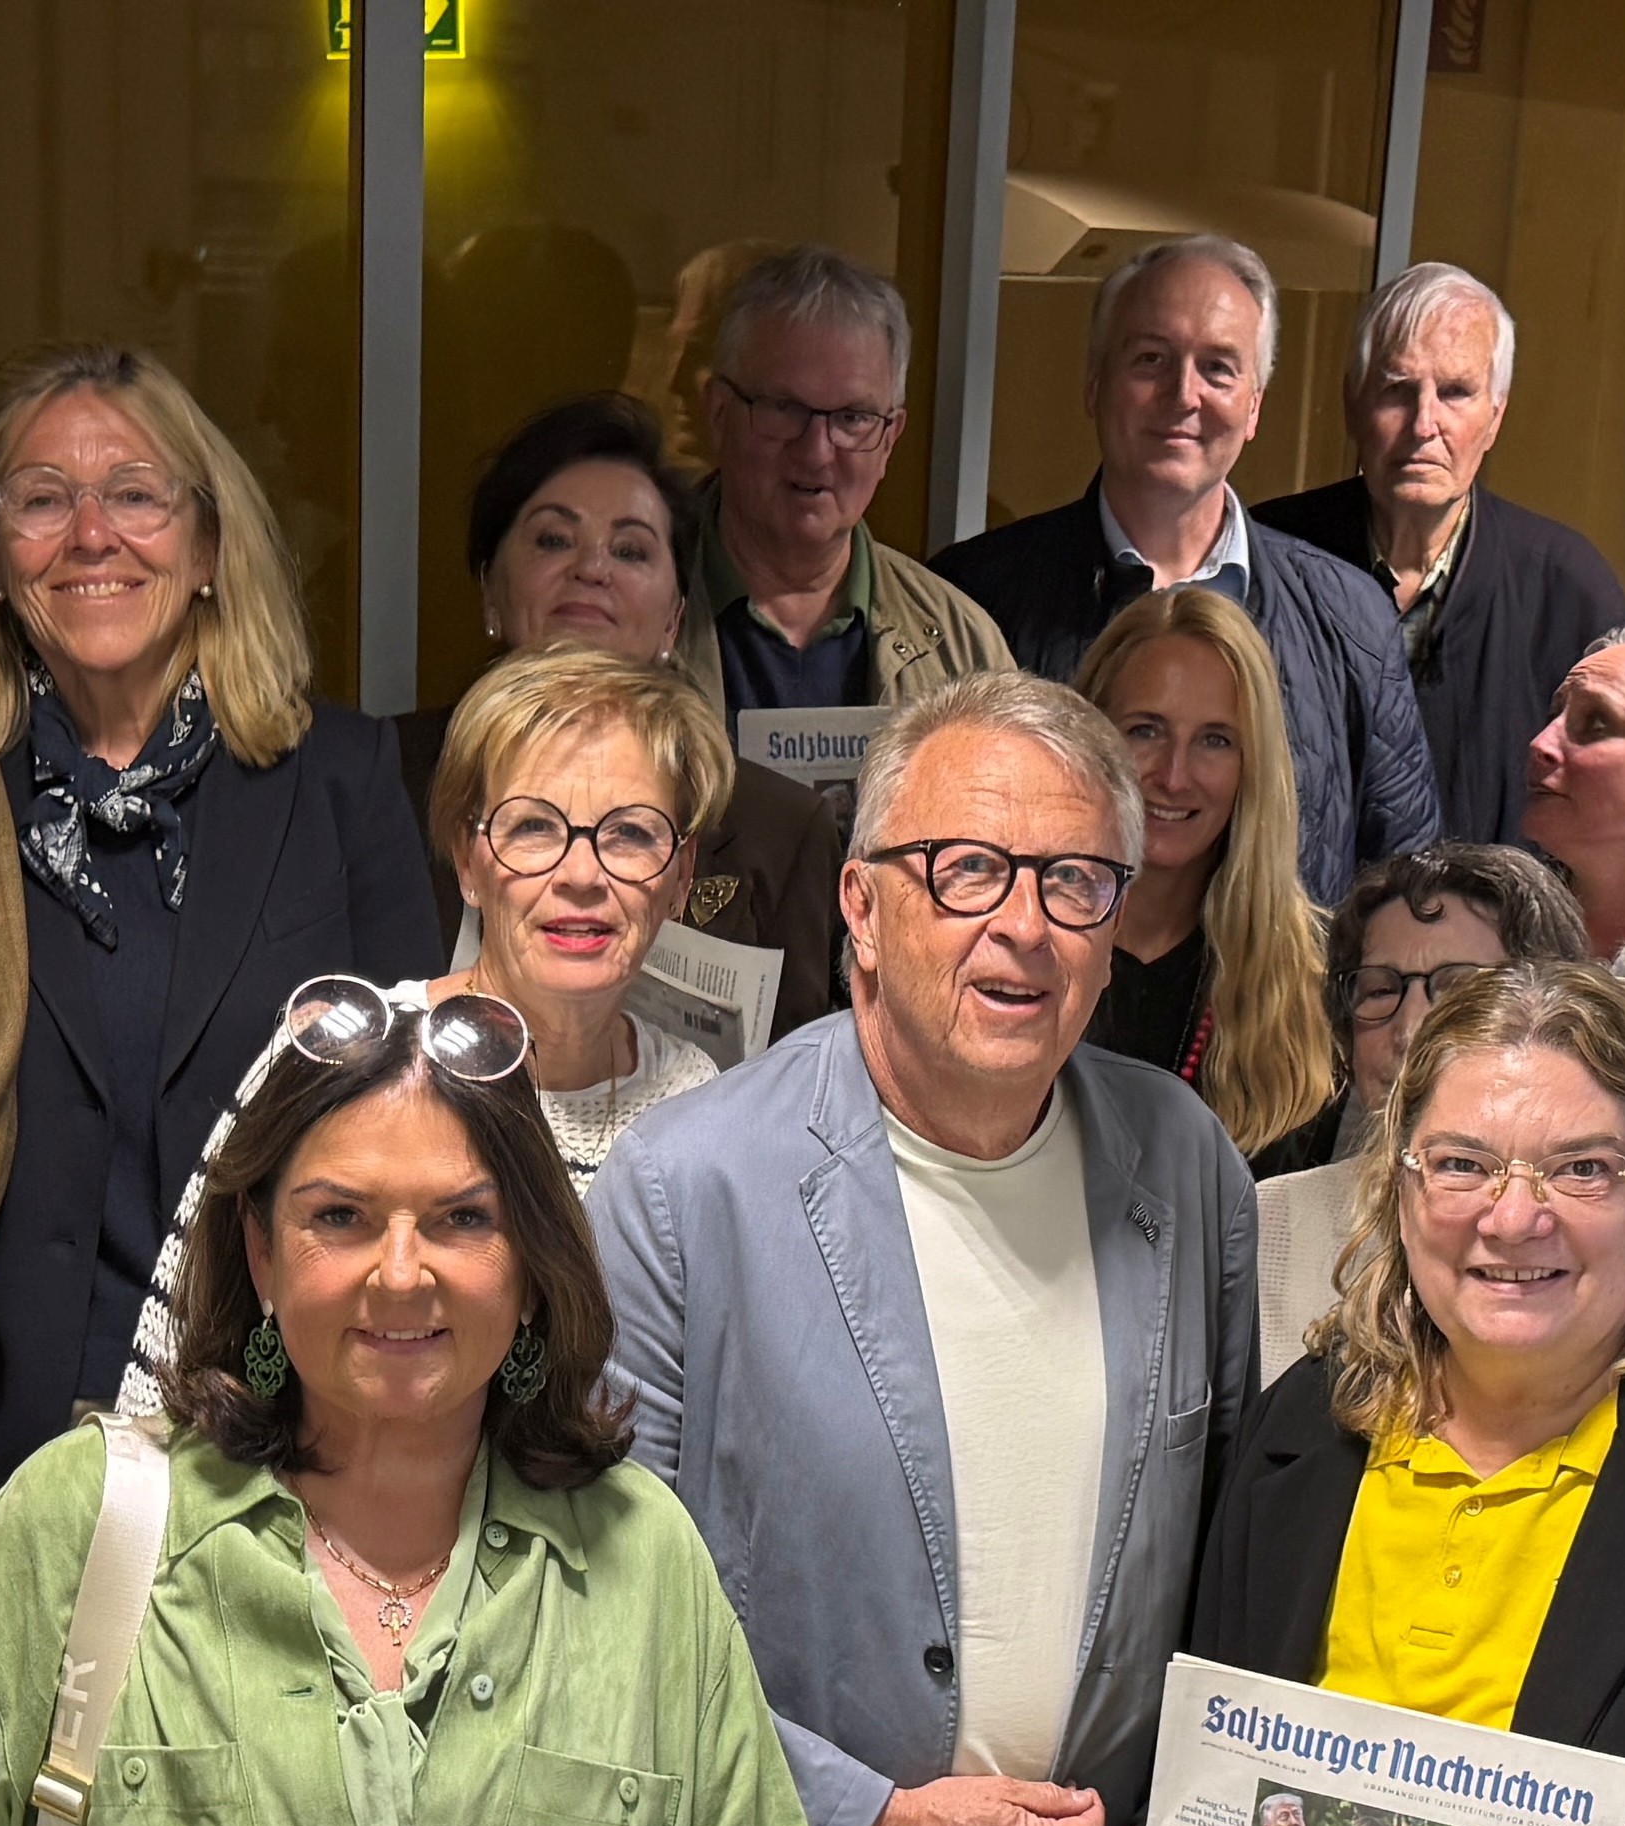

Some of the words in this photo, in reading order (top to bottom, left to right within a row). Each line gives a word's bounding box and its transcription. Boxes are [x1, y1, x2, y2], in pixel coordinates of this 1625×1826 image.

[768, 730, 871, 762] Salzburg
[1202, 1693, 1386, 1776] Salzburger
[1390, 1738, 1595, 1826] Nachrichten
